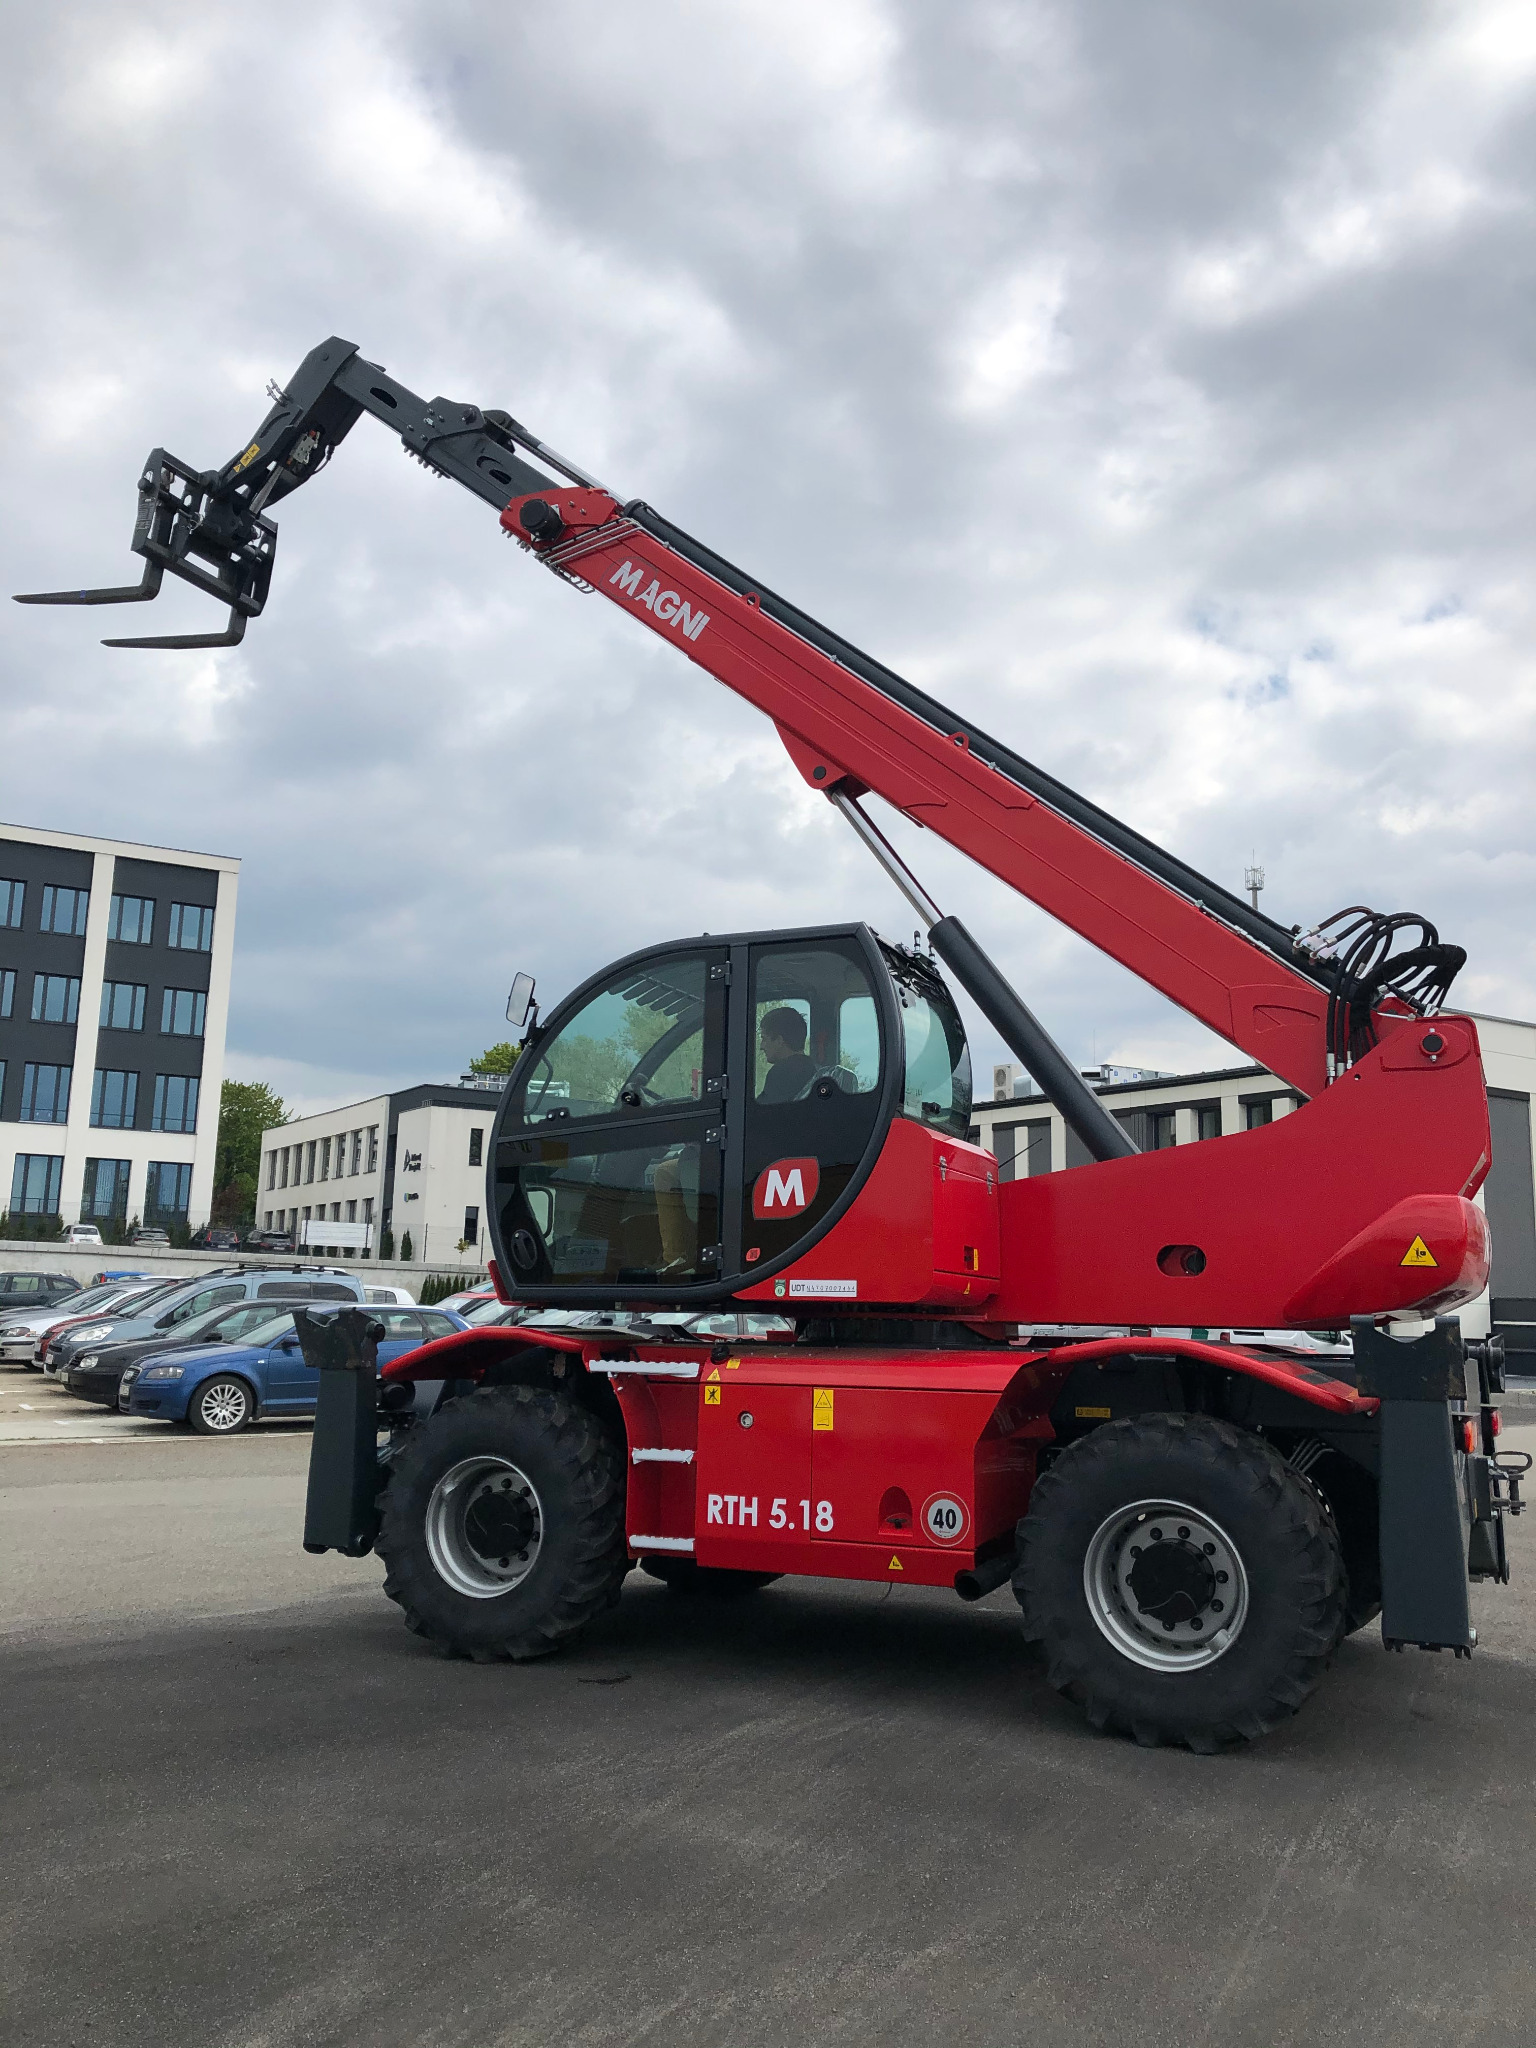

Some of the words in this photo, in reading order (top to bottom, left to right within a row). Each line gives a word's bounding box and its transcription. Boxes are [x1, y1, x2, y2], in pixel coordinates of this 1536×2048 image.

[609, 560, 711, 642] MAGNI
[763, 1168, 806, 1207] M
[791, 1284, 806, 1292] UDT
[707, 1493, 758, 1527] RTH
[768, 1498, 834, 1532] 5.18
[932, 1508, 957, 1530] 40
